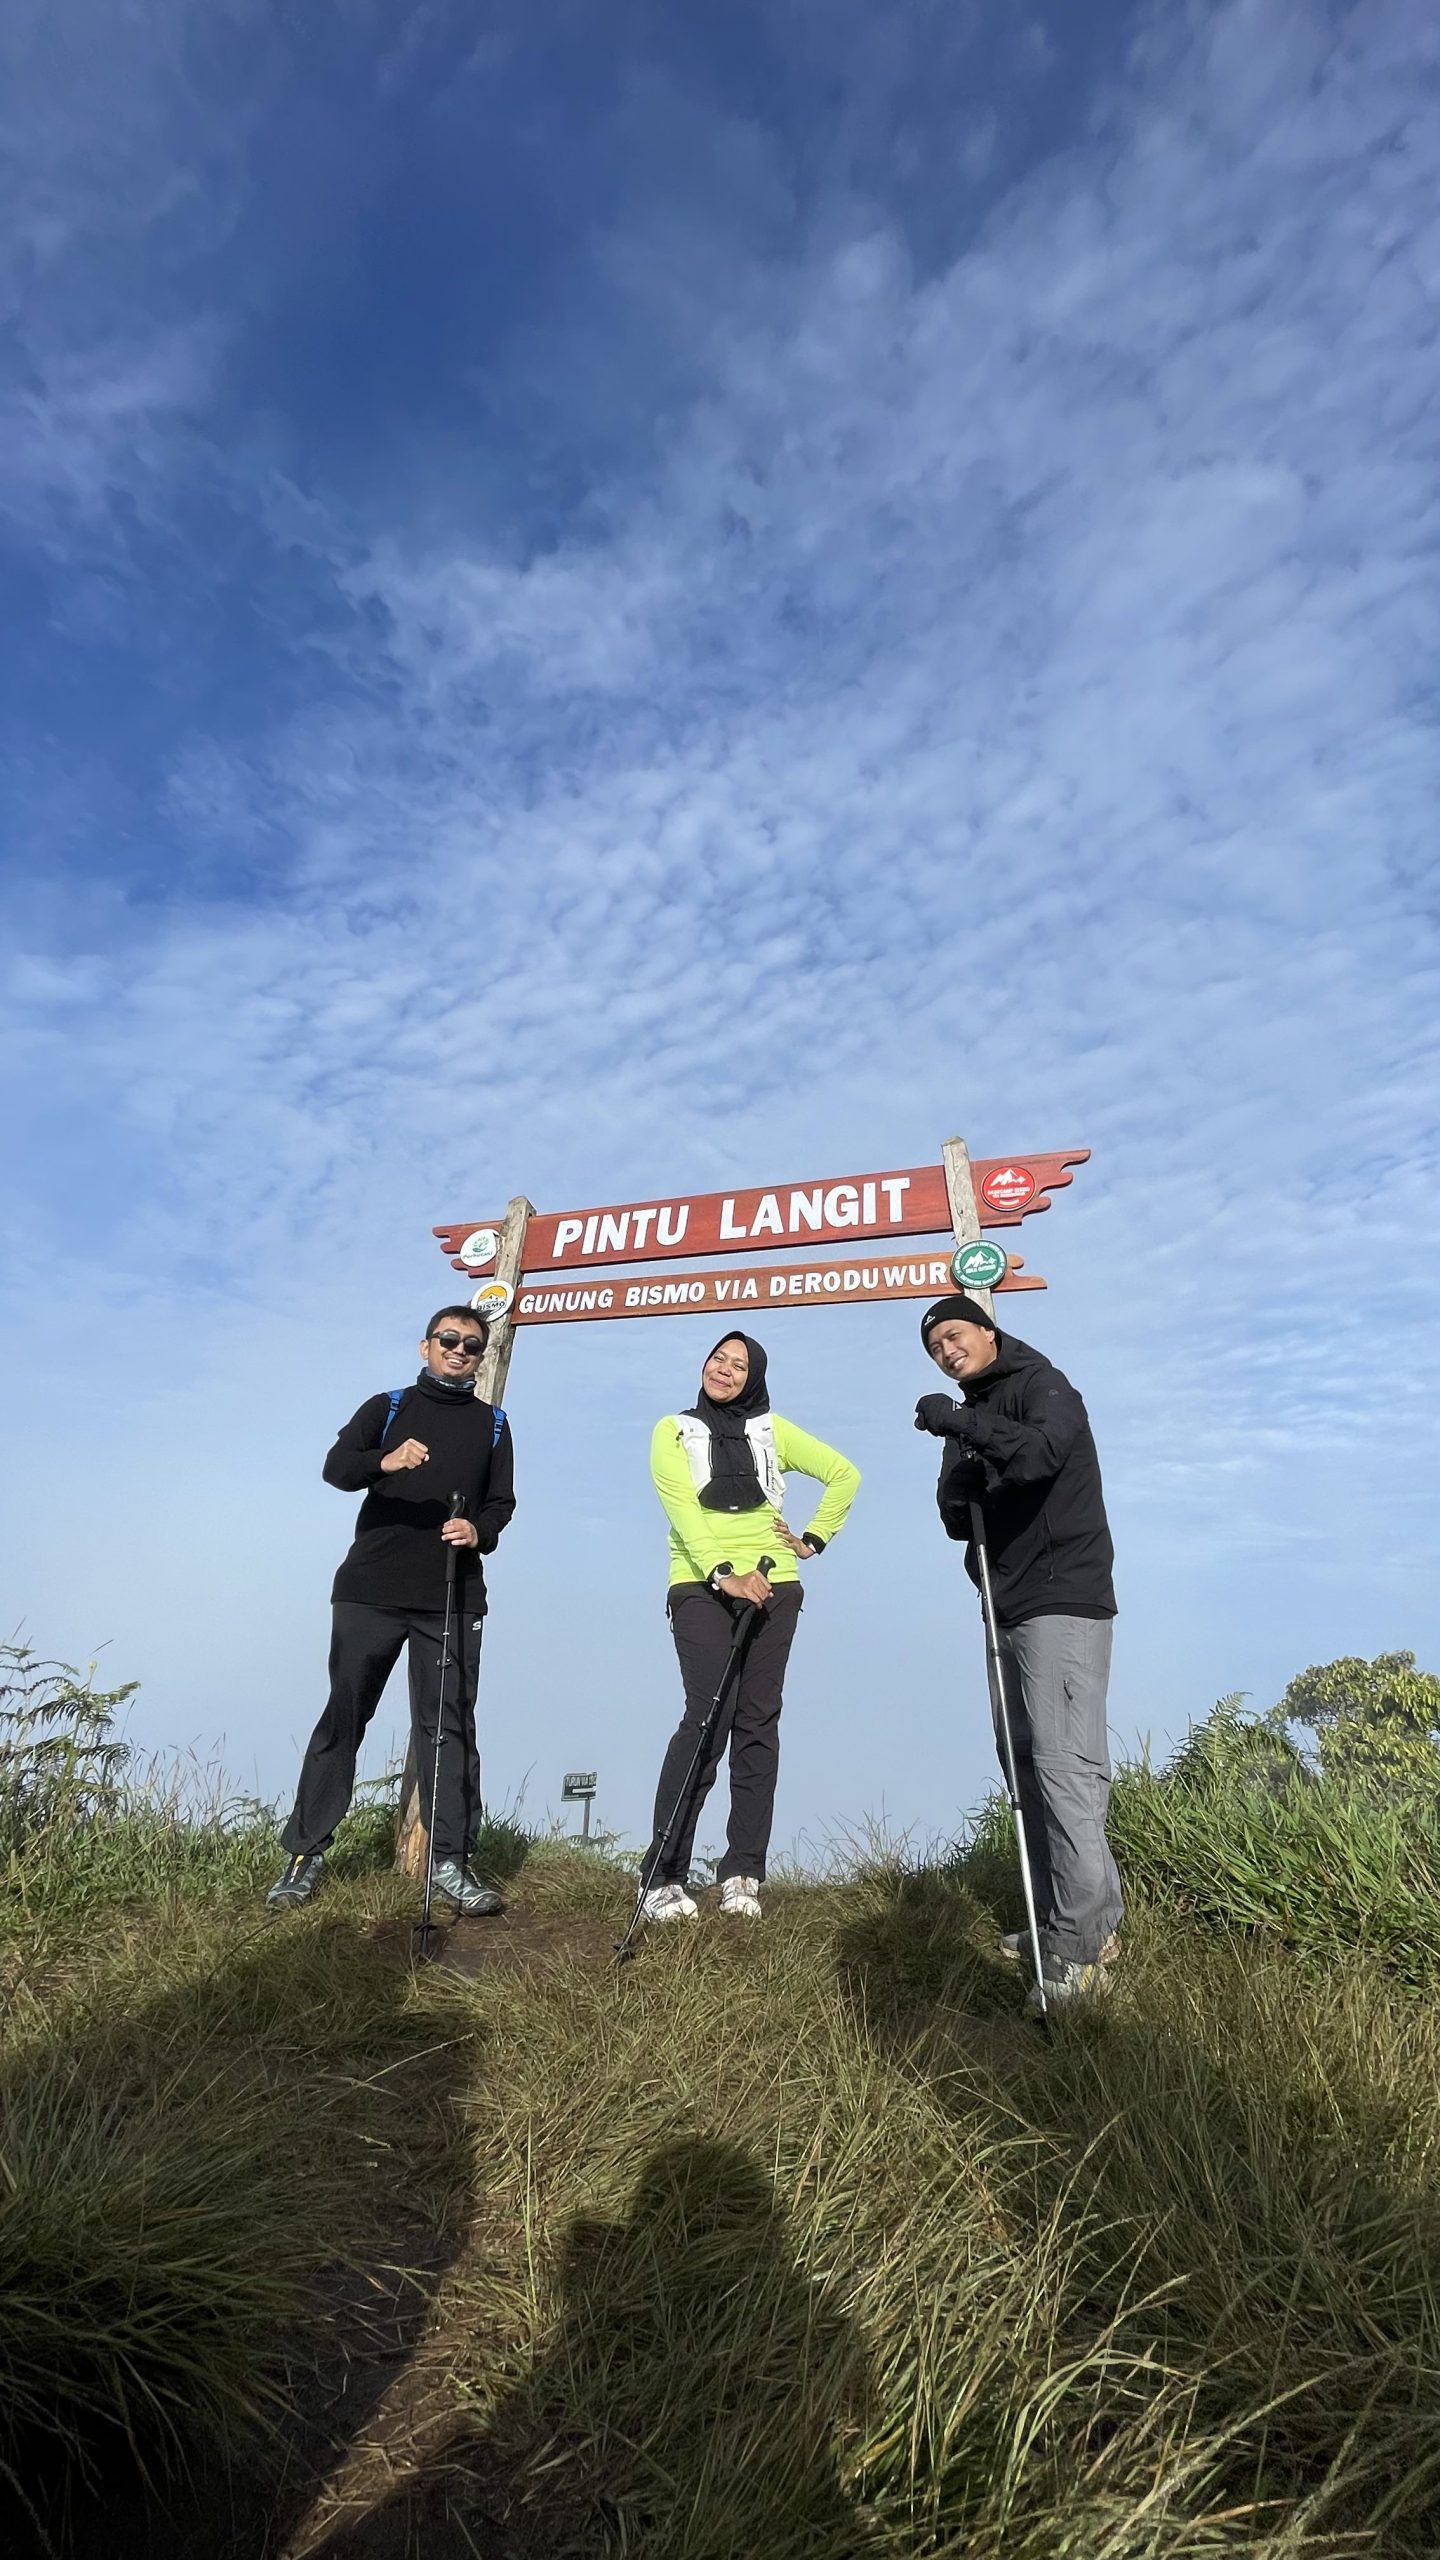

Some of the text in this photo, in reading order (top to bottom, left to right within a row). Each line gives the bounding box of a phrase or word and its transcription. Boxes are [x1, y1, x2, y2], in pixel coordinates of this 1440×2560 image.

[553, 1177, 911, 1258] PINTU LANGIT
[519, 1288, 614, 1314] GUNUNG
[624, 1281, 706, 1307] BISMO
[714, 1278, 759, 1301] VIA
[769, 1261, 947, 1298] DERODUWUR
